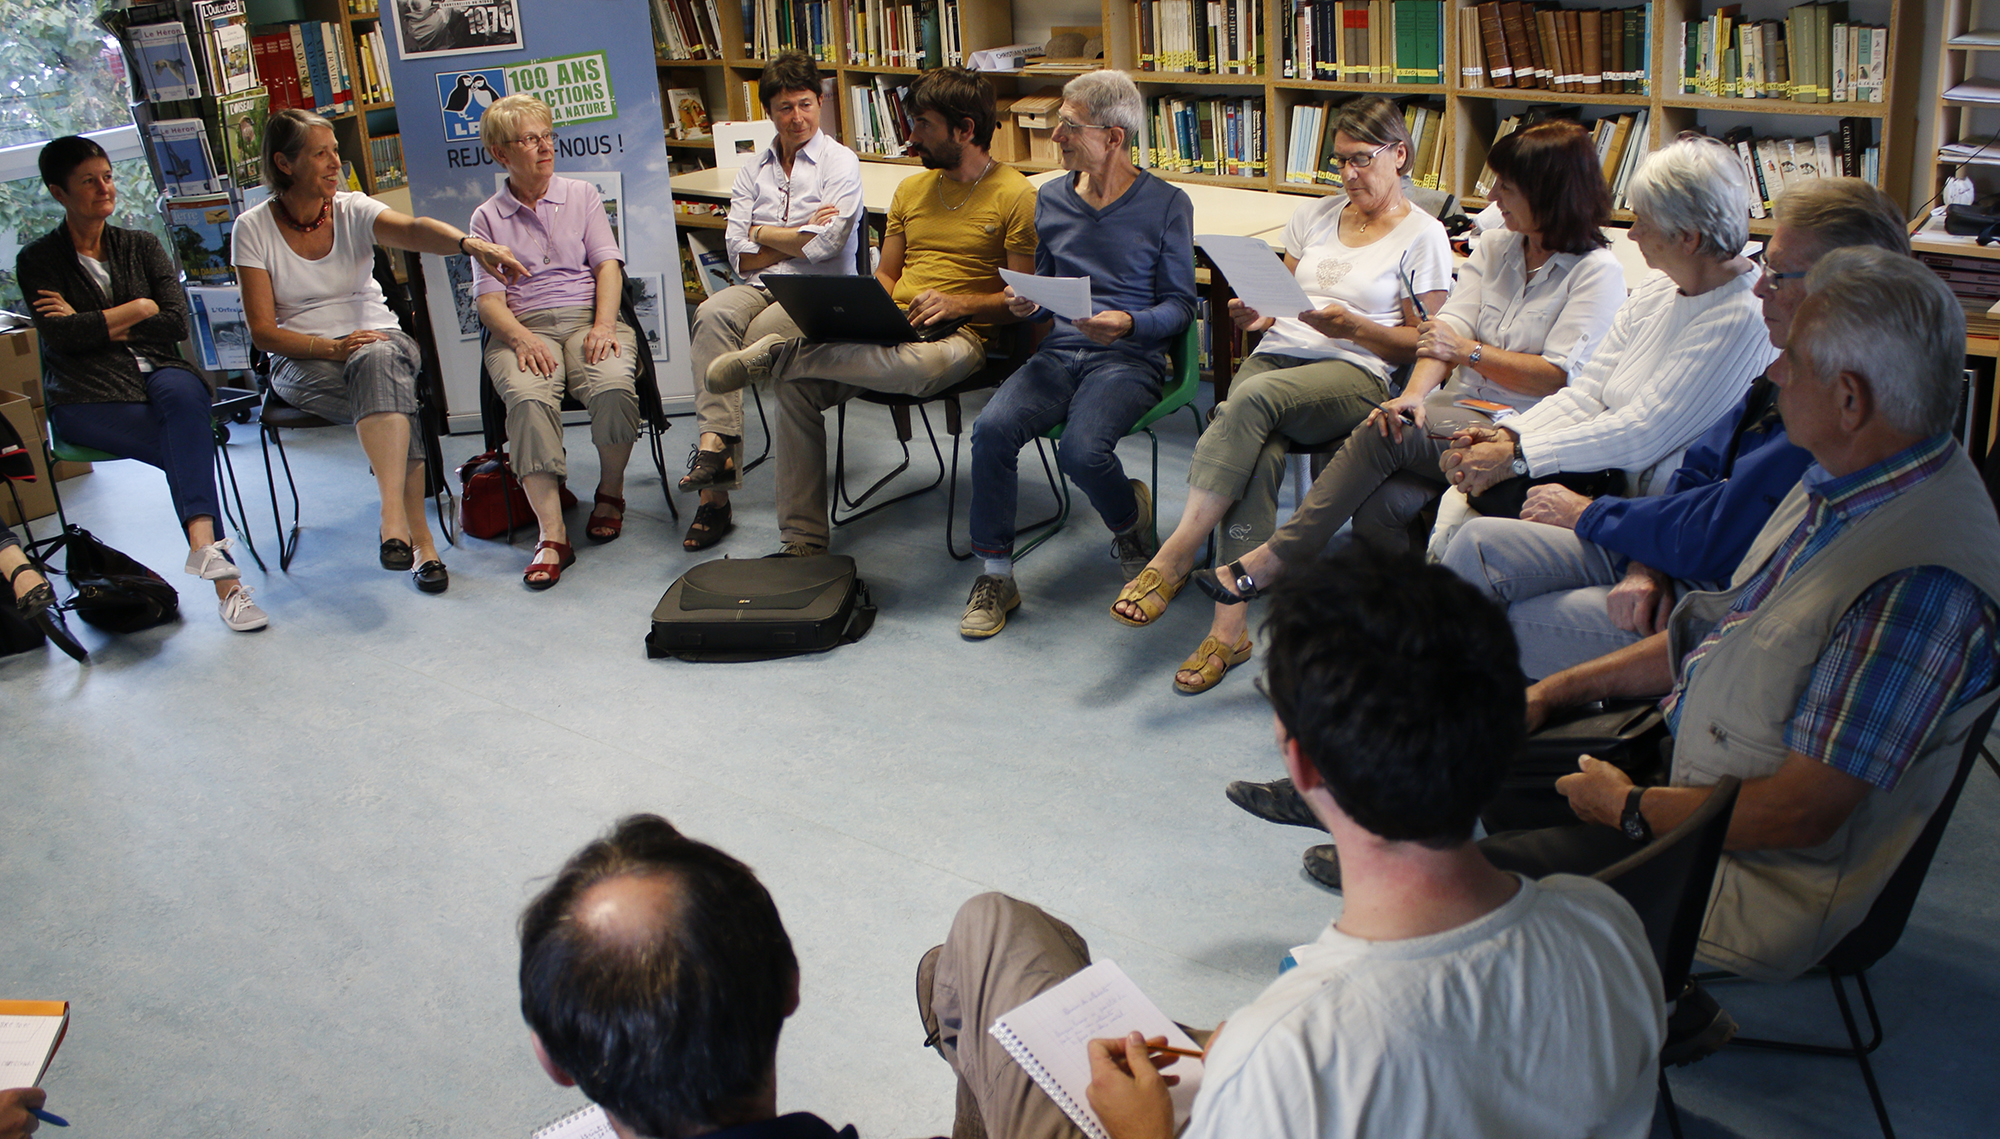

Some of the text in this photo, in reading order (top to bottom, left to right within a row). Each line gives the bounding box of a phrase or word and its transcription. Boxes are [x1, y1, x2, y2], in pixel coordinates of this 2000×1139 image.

[202, 2, 238, 17] L'Outarde
[144, 28, 181, 39] Le Héron
[508, 58, 601, 93] 100 ANS
[229, 100, 255, 116] L'OISEAU
[565, 101, 607, 118] NATURE
[160, 125, 196, 136] Le Héron
[454, 122, 481, 136] LP
[1843, 125, 1851, 151] GUIDE
[172, 209, 198, 221] Terre
[190, 265, 236, 276] MADAGASCA
